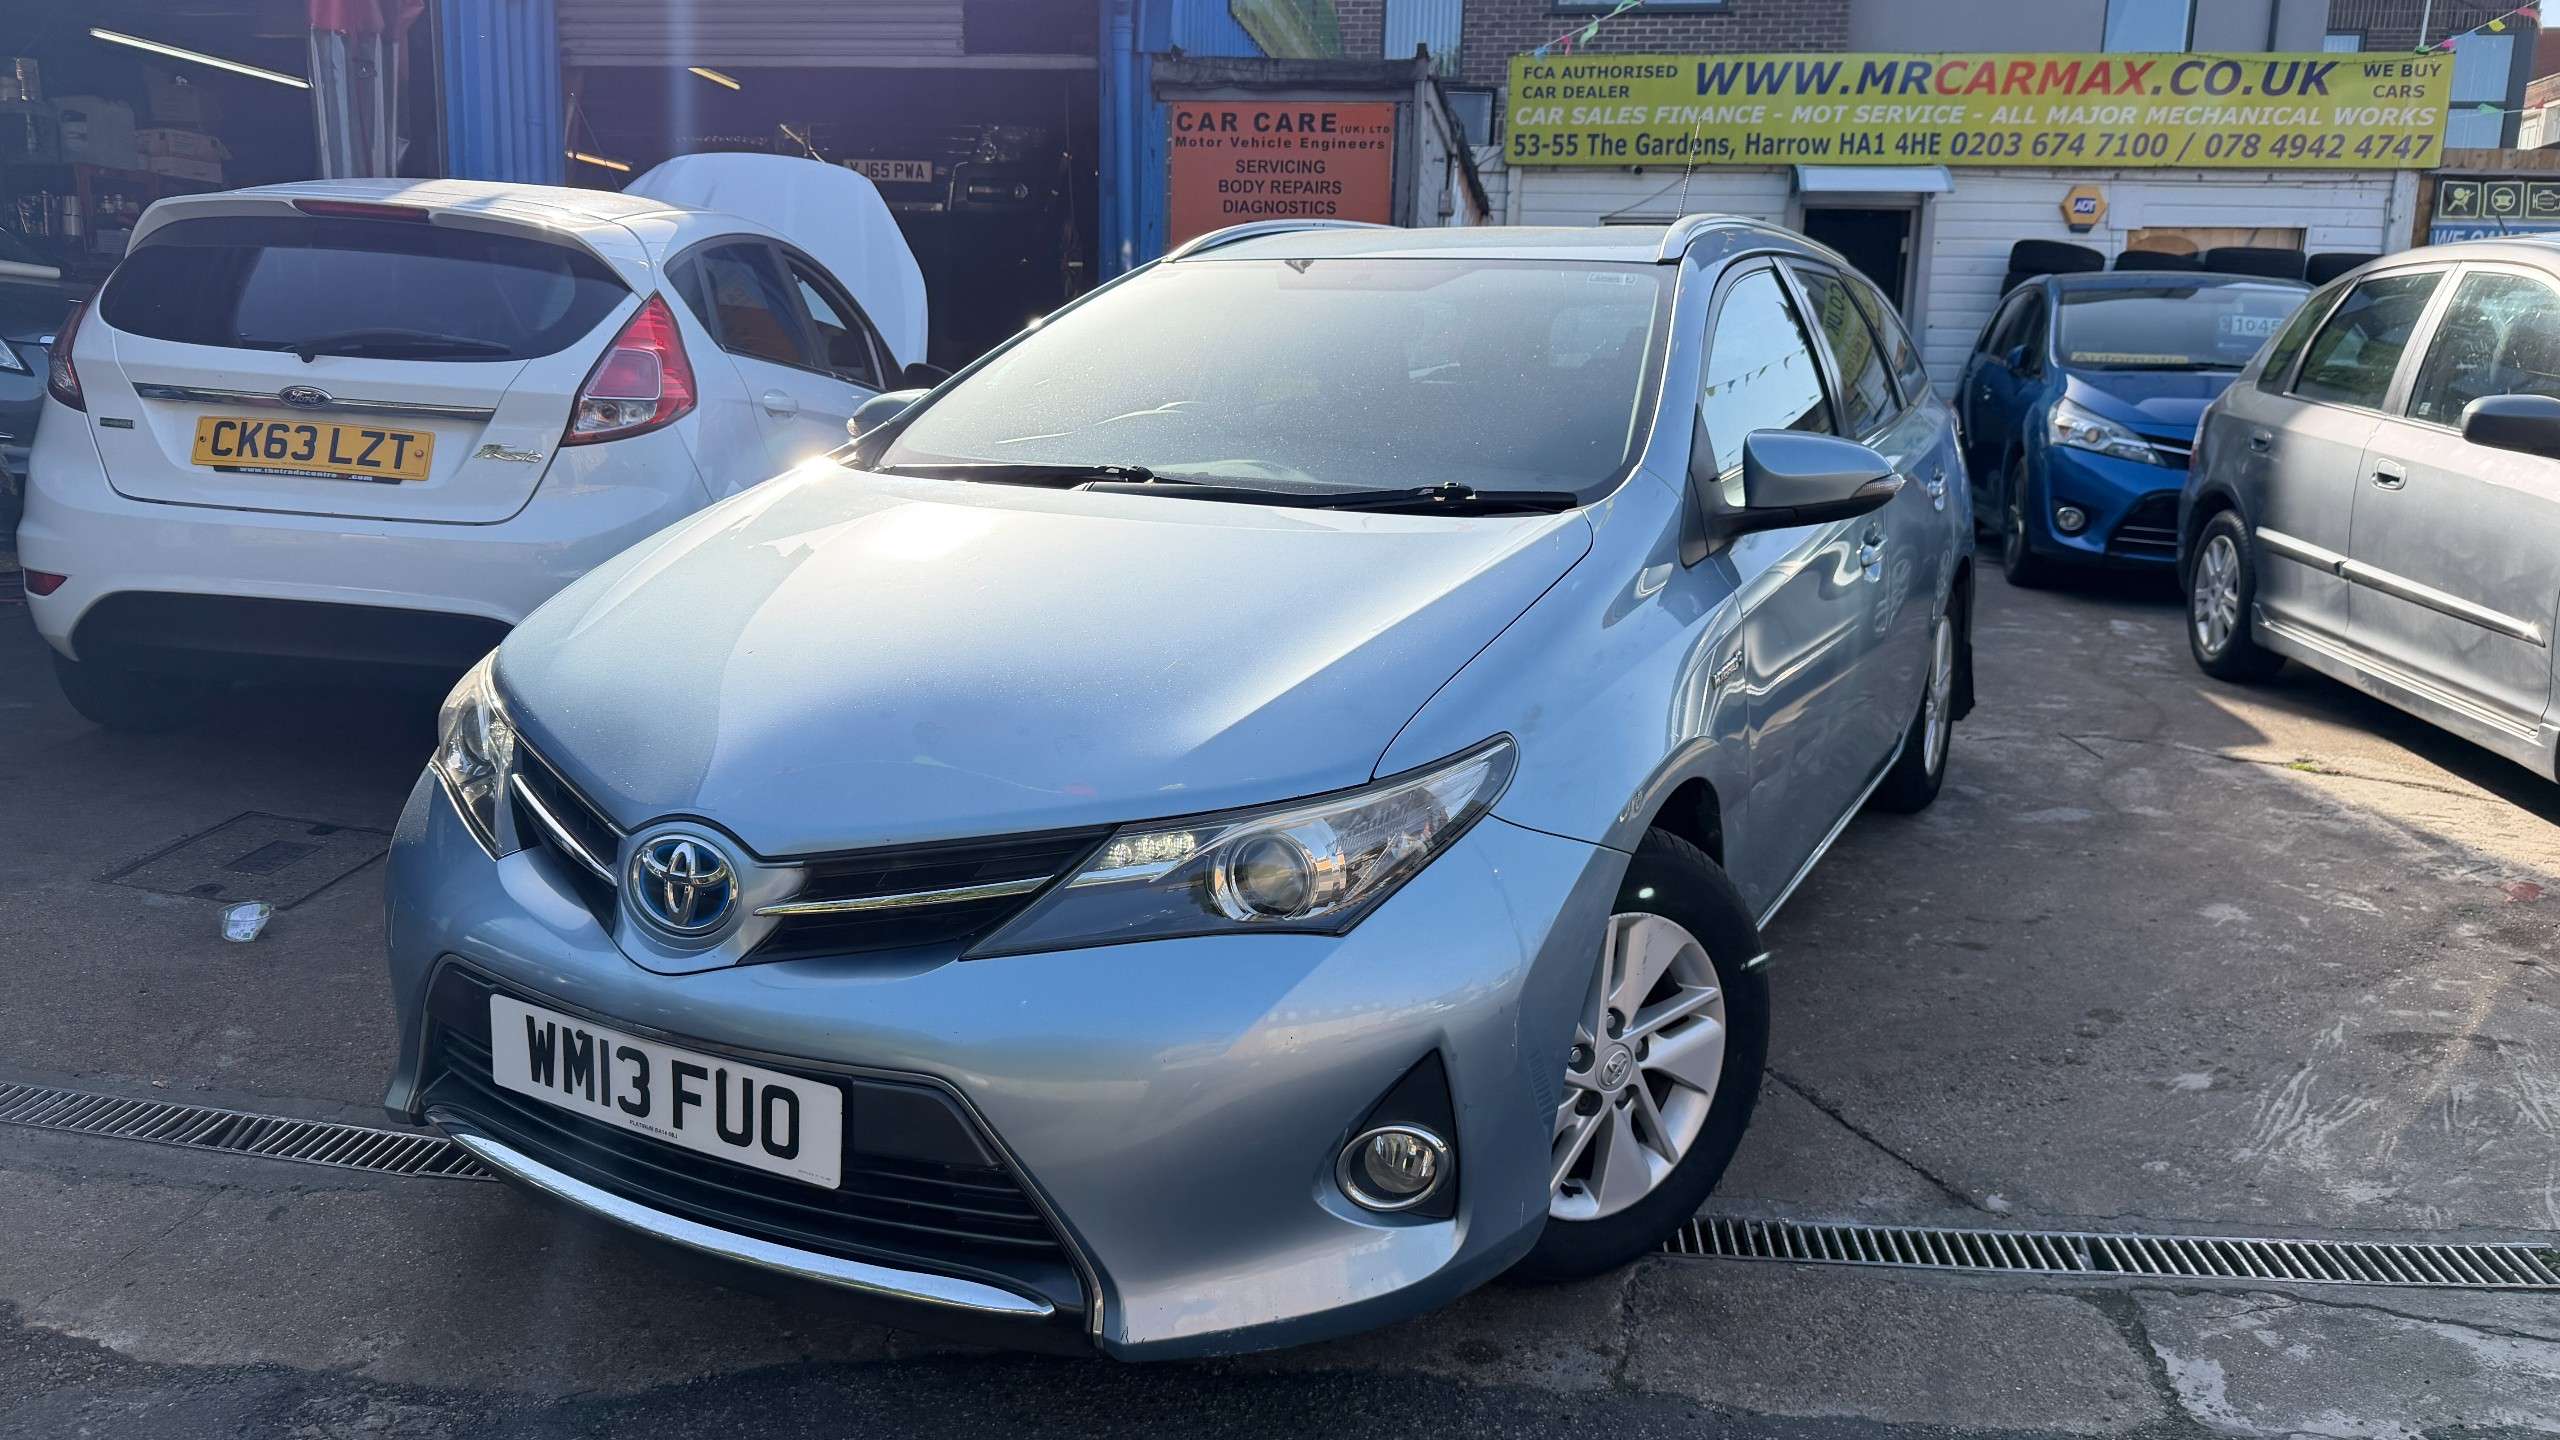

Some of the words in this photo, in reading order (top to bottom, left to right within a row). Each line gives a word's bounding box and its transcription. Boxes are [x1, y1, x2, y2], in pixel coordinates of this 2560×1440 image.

[1523, 66, 1555, 79] FCA
[1561, 65, 1678, 79] AUTHORISED
[2363, 64, 2393, 77] WE
[2401, 63, 2442, 77] BUY
[1696, 60, 2340, 97] WWW.MRCARMAX.CO.UK
[1522, 86, 1556, 98] CAR
[1563, 85, 1630, 98] DEALER
[2372, 84, 2425, 98] CARS
[1176, 111, 1238, 132] CAR
[1253, 112, 1337, 133] CARE
[1340, 125, 1366, 135] (UK)
[1369, 125, 1391, 135] LTD
[1515, 106, 1563, 125] CAR
[1569, 106, 1648, 125] SALES
[1654, 105, 1766, 125] FINANCE
[1790, 105, 1849, 124] MOT
[1852, 105, 1966, 124] SERVICE
[1990, 105, 2037, 124] ALL
[2045, 105, 2137, 125] MAJOR
[2143, 105, 2323, 126] MECHANICAL
[2333, 106, 2438, 126] WORKS
[1175, 136, 1223, 148] Motor
[1230, 136, 1292, 149] Vehicle
[1300, 137, 1386, 152] Engineers
[1513, 133, 1579, 156] 53-55
[1587, 133, 1627, 156] The
[1634, 132, 1736, 160] Gardens,
[1745, 132, 1831, 156] Harrow
[1839, 132, 1886, 155] HA1
[1894, 132, 1942, 156] 4HE
[1950, 132, 2023, 157] 0203
[2031, 132, 2086, 157] 674
[2095, 132, 2169, 158] 7100
[2204, 132, 2261, 158] 078
[2268, 133, 2346, 159] 4942
[2353, 133, 2435, 160] 4747
[1235, 159, 1326, 174] SERVICING
[1218, 179, 1265, 194] BODY
[1270, 180, 1342, 195] REPAIRS
[1223, 200, 1337, 215] DIAGNOSTICS
[210, 420, 318, 461] CK63
[328, 428, 415, 471] LZT
[525, 1014, 651, 1118] WM13
[671, 1059, 800, 1161] FUO
